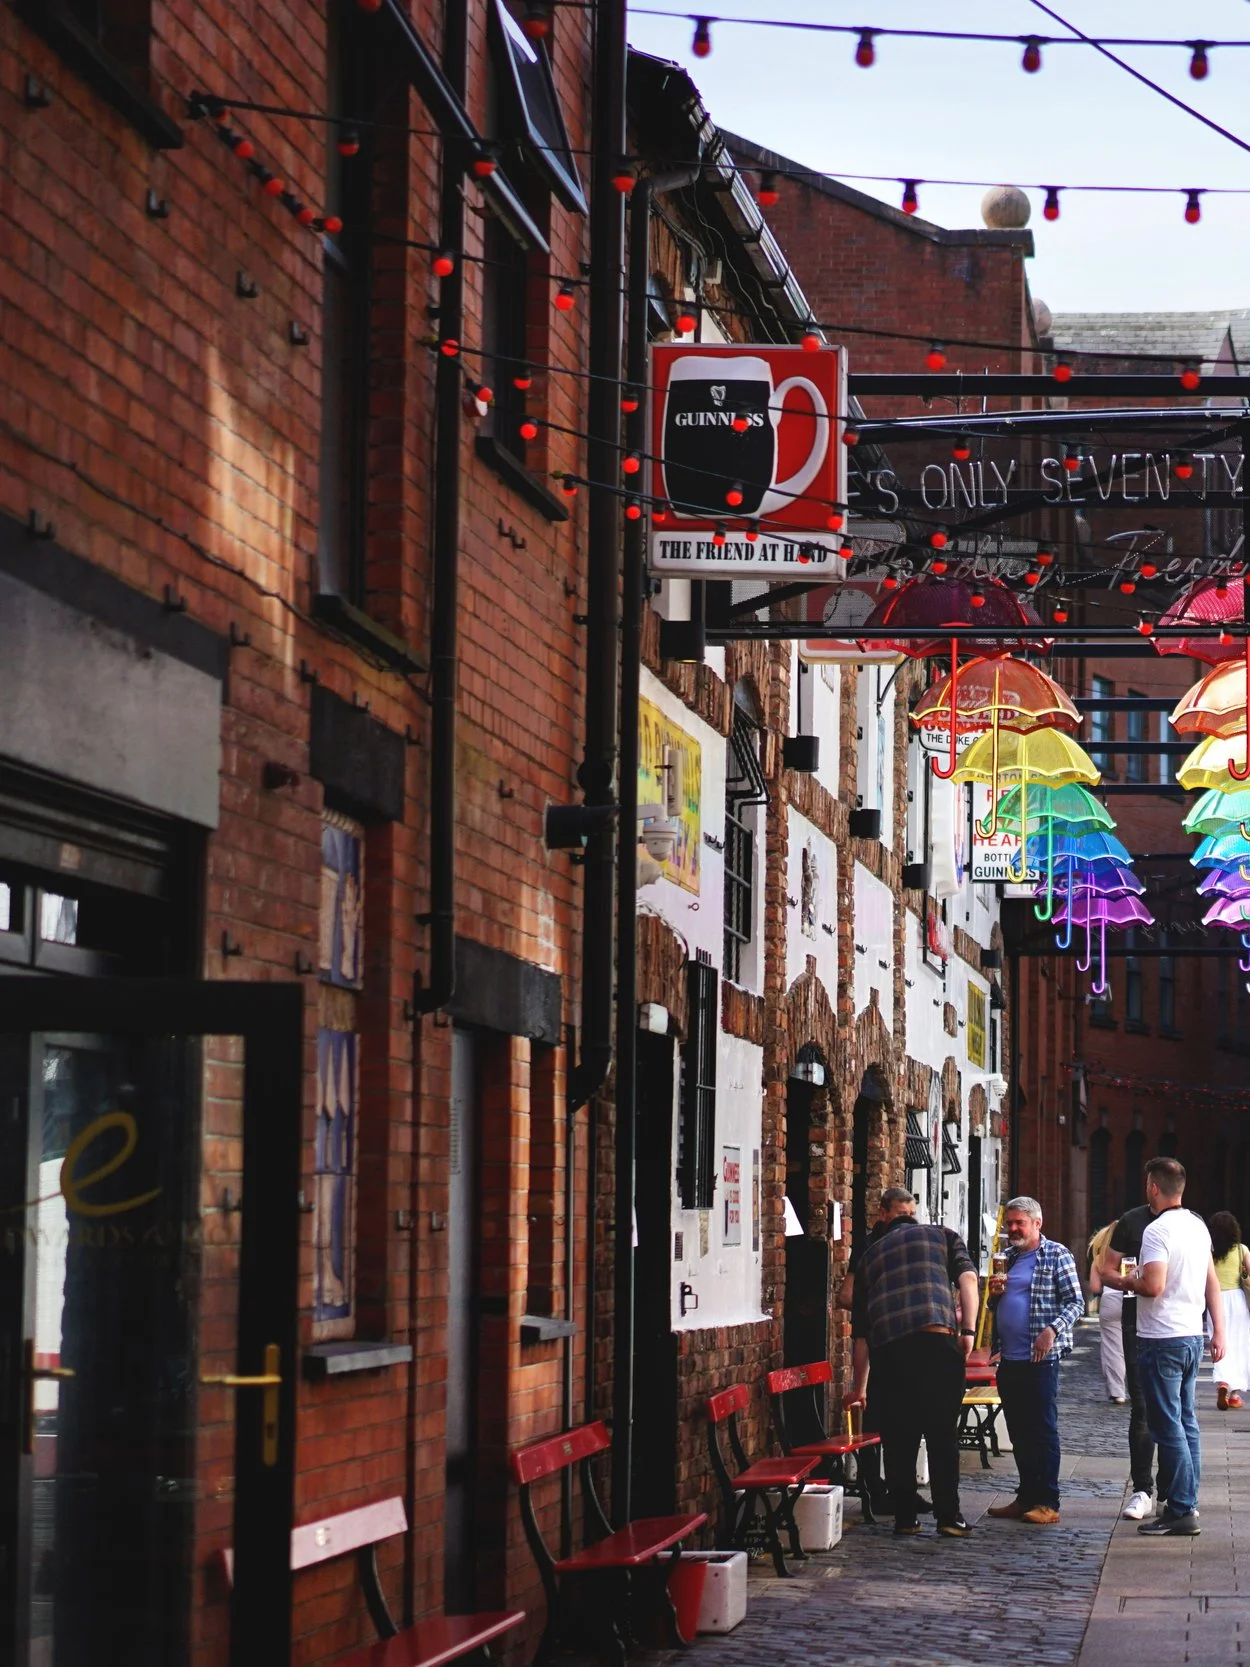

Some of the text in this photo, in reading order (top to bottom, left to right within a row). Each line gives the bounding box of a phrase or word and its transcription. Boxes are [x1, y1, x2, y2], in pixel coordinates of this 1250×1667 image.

[675, 411, 764, 427] GUINNSS
[919, 459, 1016, 509] ONLY
[1040, 454, 1170, 502] SEVEN
[660, 540, 691, 559] THE
[697, 541, 754, 562] FRIEND
[759, 542, 779, 562] AT
[927, 733, 943, 744] THE
[946, 735, 970, 746] DKE
[974, 832, 1022, 847] HEA
